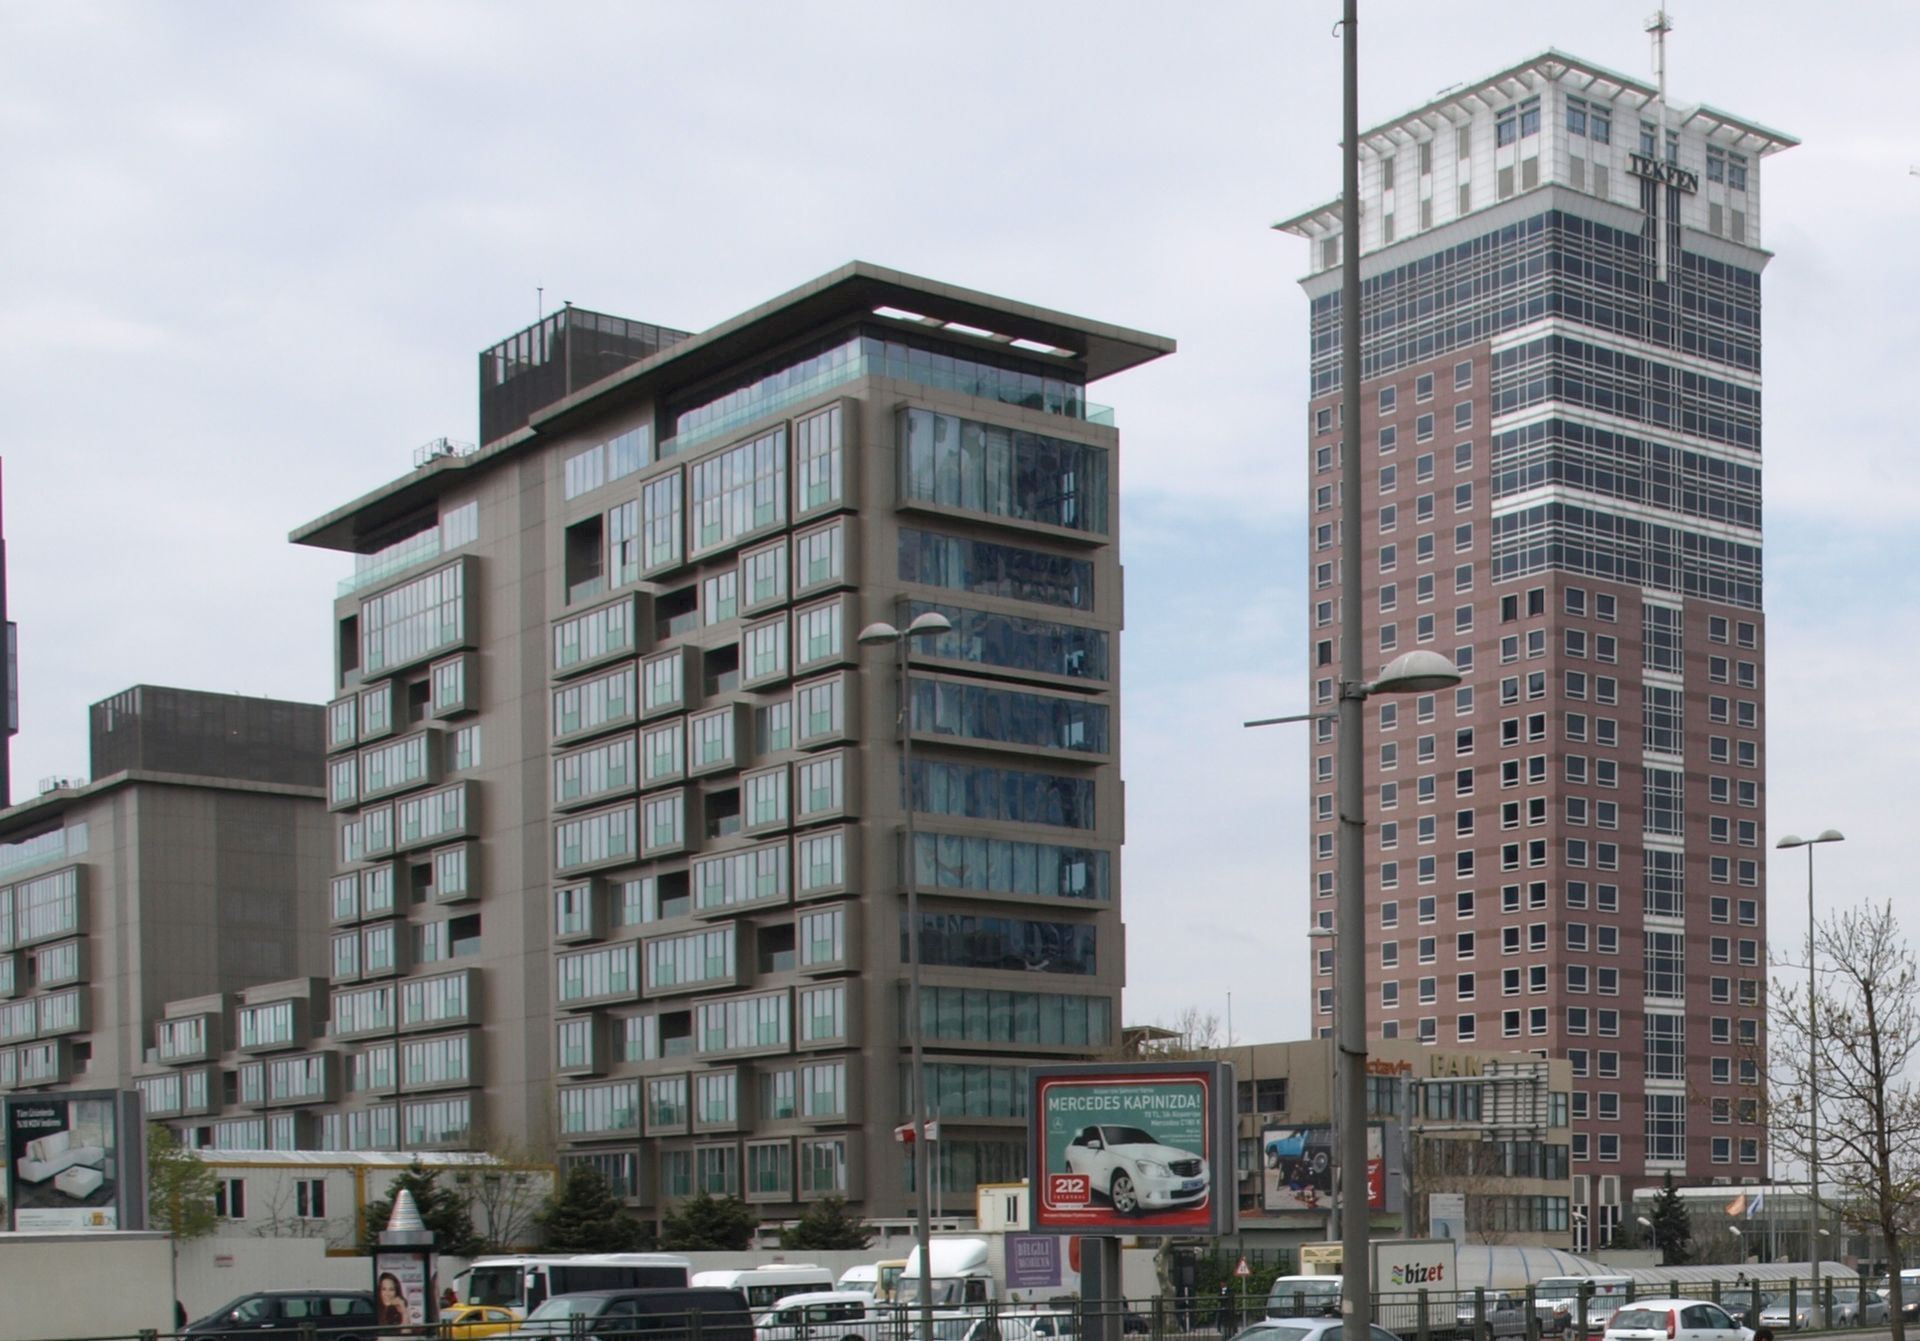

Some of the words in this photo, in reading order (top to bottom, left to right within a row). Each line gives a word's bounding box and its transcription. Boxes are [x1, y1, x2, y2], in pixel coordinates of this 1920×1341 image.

[1629, 153, 1698, 191] TEKFEN
[1366, 1057, 1413, 1076] ctavis
[1048, 1096, 1120, 1112] MERCEDES
[1124, 1094, 1201, 1110] KAPINIZDA!
[1056, 1179, 1084, 1193] 212
[1405, 1262, 1444, 1284] bizet
